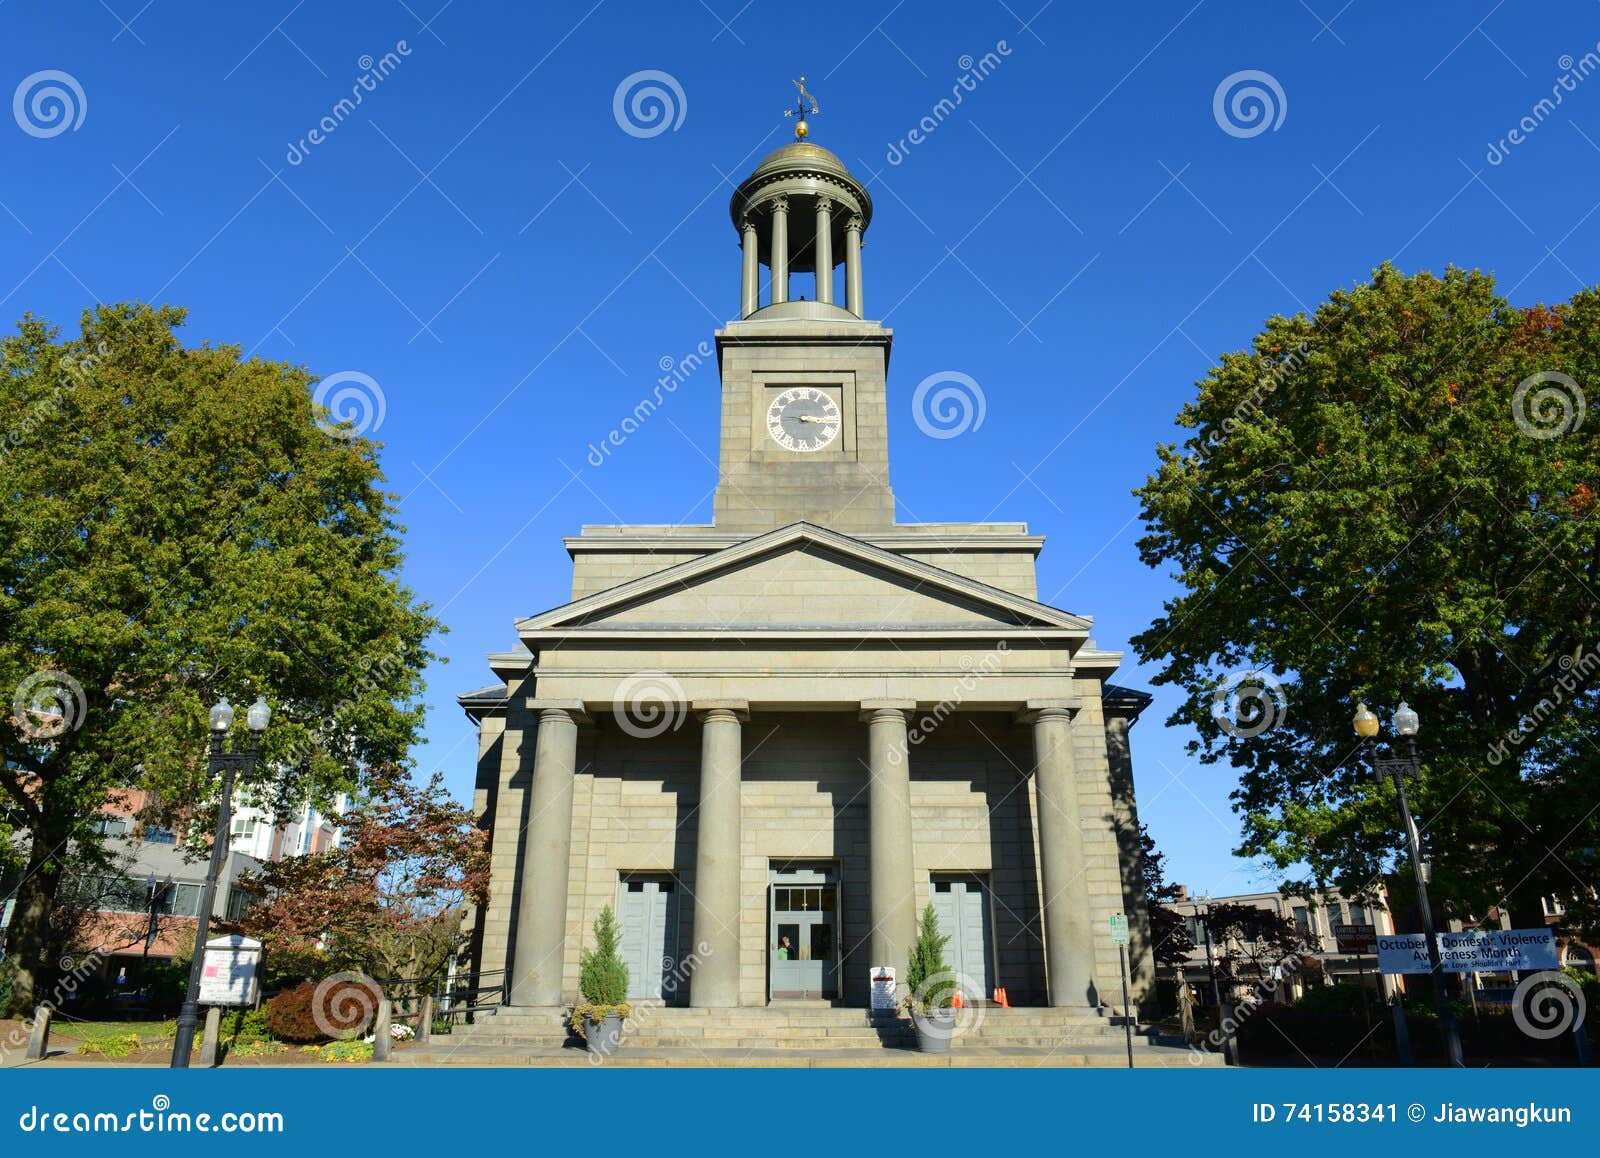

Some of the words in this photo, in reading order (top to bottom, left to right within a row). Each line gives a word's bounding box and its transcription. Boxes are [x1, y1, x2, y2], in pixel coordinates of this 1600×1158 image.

[1380, 938, 1427, 951] October
[1442, 935, 1496, 949] Domestic
[1499, 934, 1550, 947] Violence
[1413, 951, 1477, 961] Awreness
[1481, 946, 1521, 959] Month
